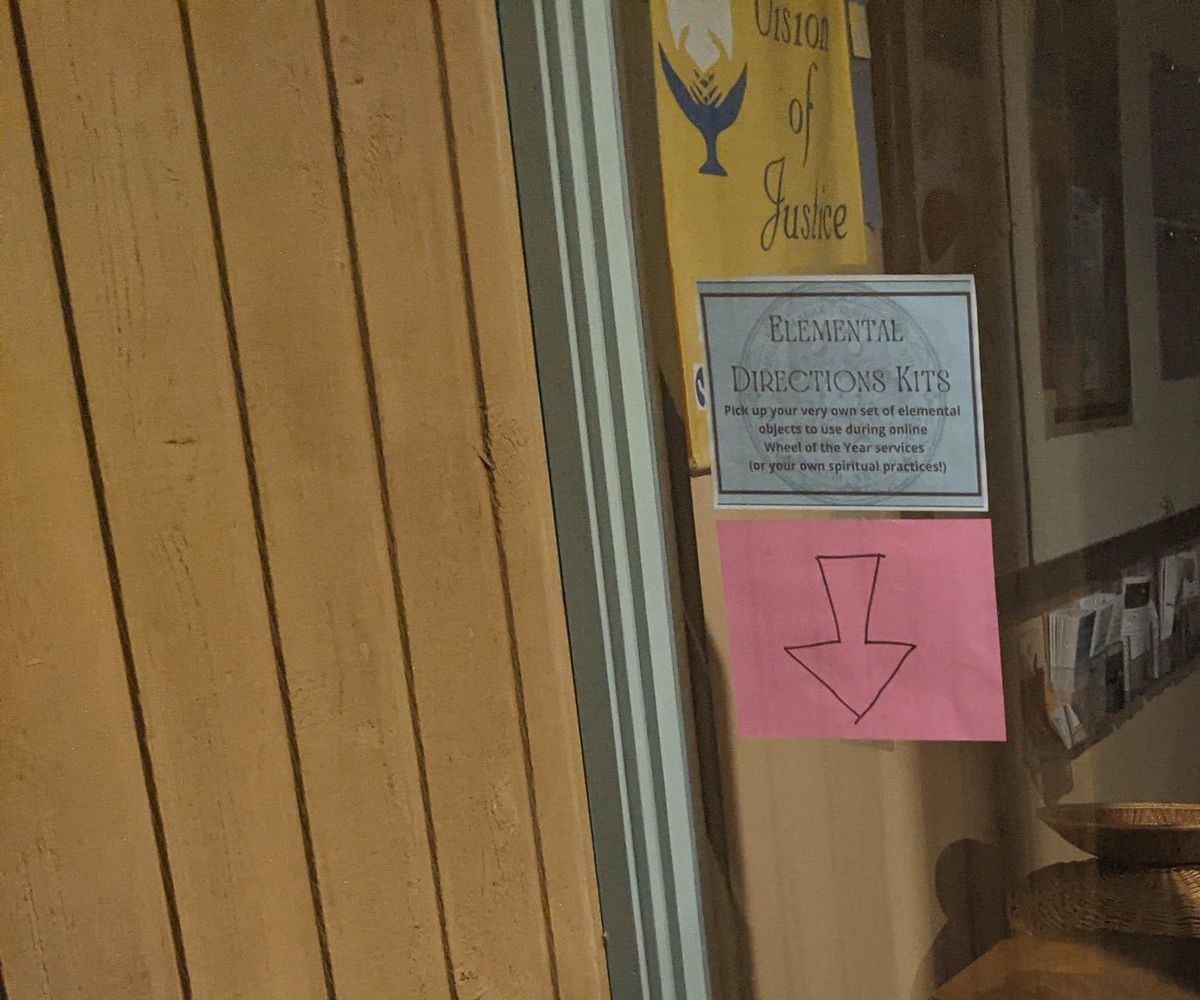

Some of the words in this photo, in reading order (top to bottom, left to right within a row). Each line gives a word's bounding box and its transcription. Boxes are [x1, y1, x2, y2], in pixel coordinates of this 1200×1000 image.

[789, 62, 818, 167] of
[760, 157, 848, 252] Justice
[767, 314, 903, 343] ELEMENTAL
[730, 365, 886, 393] DIRECTIONS
[895, 364, 951, 393] KITS
[724, 404, 749, 417] Pick
[752, 407, 768, 419] up
[769, 407, 798, 419] your
[800, 407, 827, 419] very
[830, 407, 857, 416] own
[859, 406, 879, 416] set
[881, 404, 895, 417] of
[897, 404, 960, 416] elemental
[758, 422, 802, 437] objects
[804, 424, 818, 434] to
[820, 425, 842, 435] use
[845, 422, 886, 438] during
[888, 423, 928, 436] online
[763, 440, 802, 452] Wheel
[804, 441, 817, 453] of
[820, 442, 840, 453] the
[842, 442, 872, 453] Year
[874, 441, 924, 453] services
[748, 460, 766, 472] (or
[768, 462, 796, 473] your
[799, 462, 825, 471] own
[828, 459, 879, 474] spiritual
[882, 460, 947, 474] practices!)
